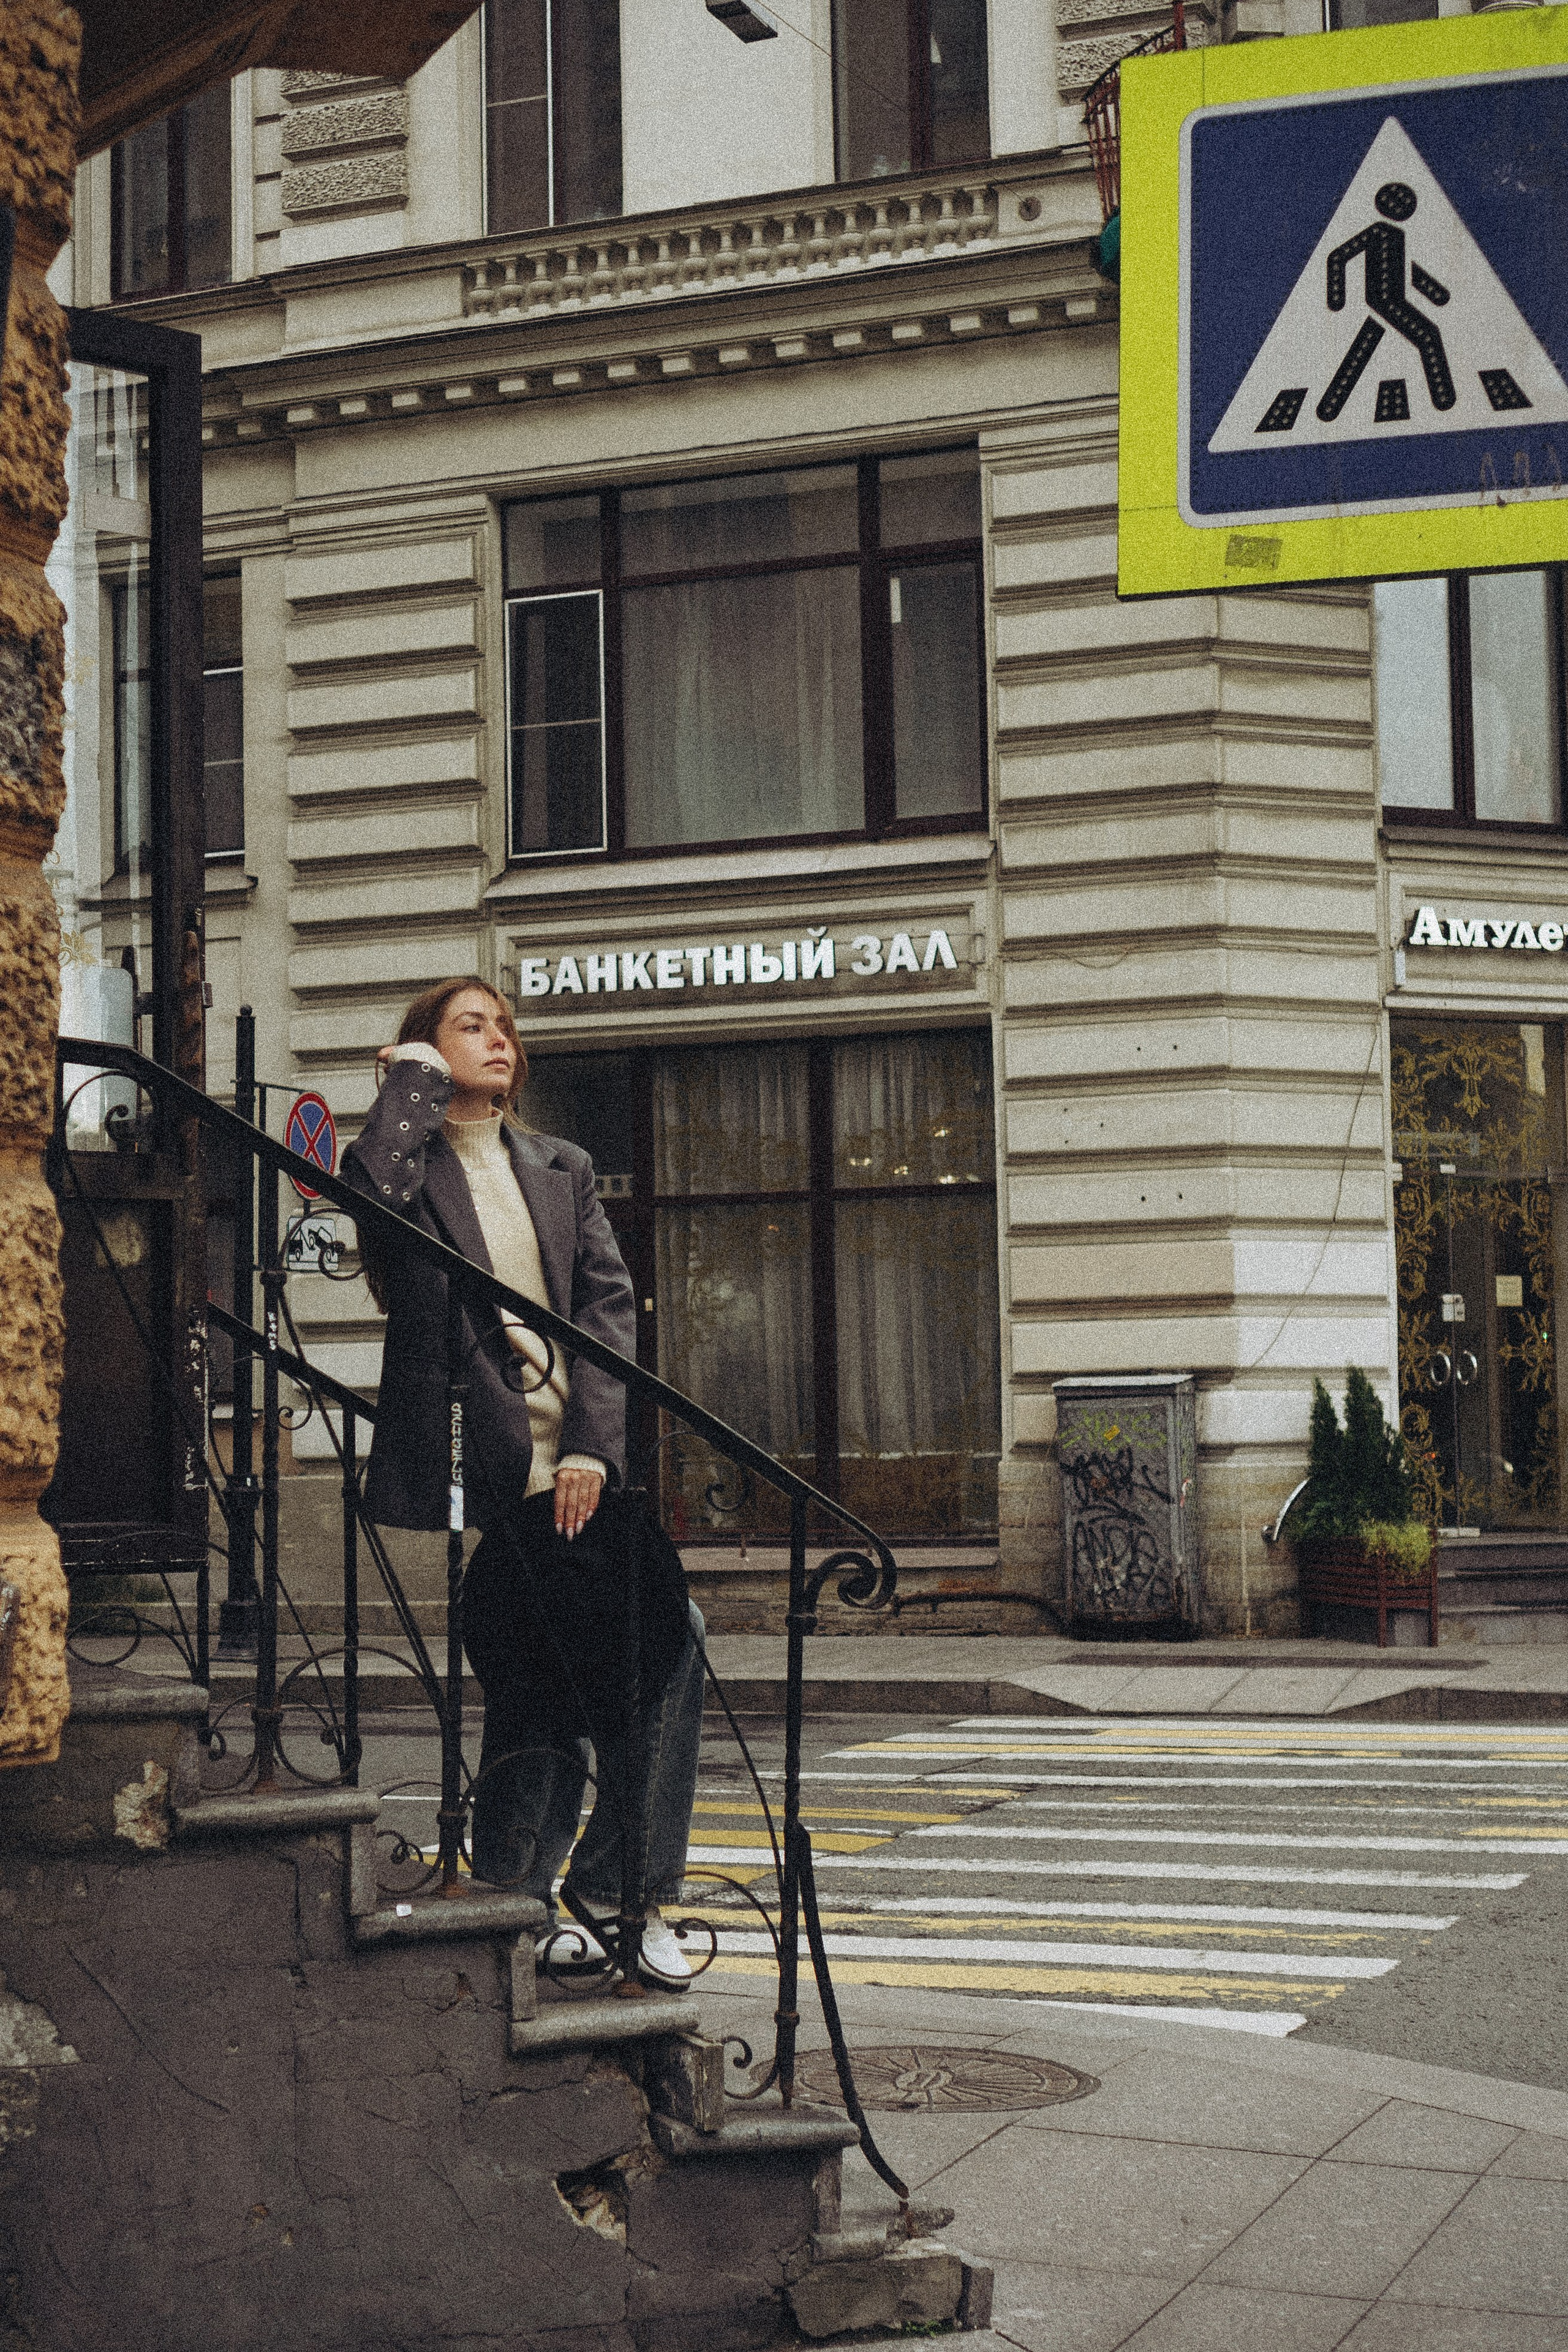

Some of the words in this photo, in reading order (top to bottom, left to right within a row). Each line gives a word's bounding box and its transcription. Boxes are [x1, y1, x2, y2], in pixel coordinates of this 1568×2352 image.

[1409, 906, 1568, 951] Амуле
[521, 925, 835, 997] БАНКЕТНЫЙ
[851, 930, 958, 976] ЗАЛ
